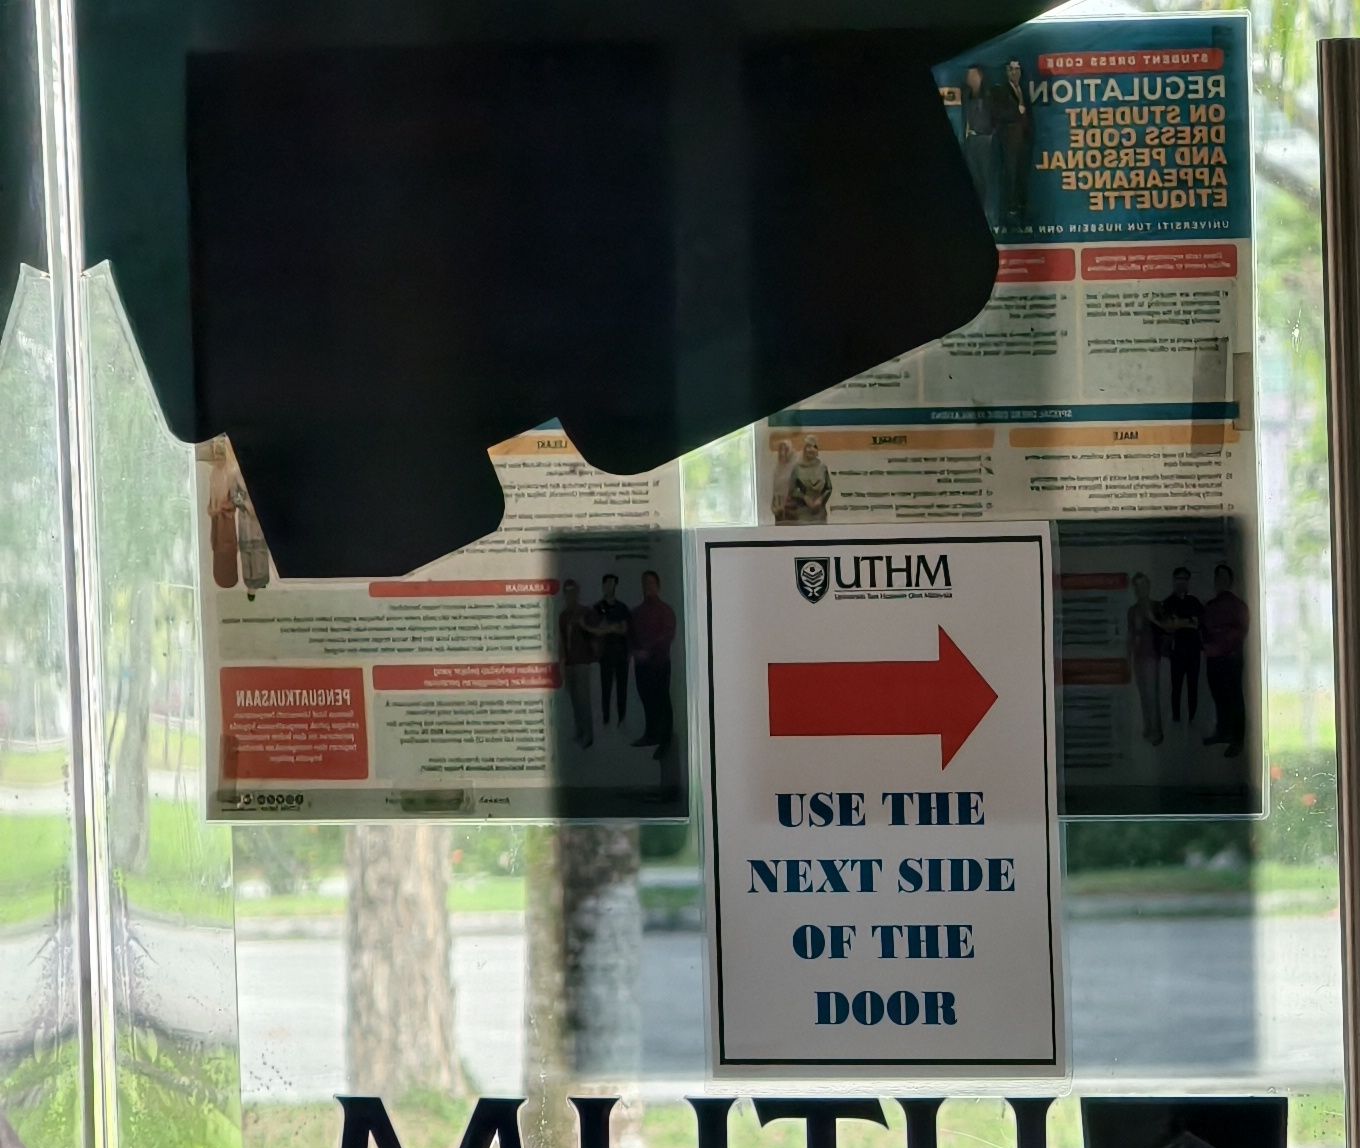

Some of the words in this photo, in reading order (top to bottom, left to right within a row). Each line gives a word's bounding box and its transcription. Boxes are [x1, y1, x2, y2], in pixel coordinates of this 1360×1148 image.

[834, 555, 952, 588] UTHM
[775, 792, 866, 828] USE
[882, 791, 986, 827] THE
[747, 859, 882, 893] NEXT
[898, 858, 1016, 893] SIDE
[793, 925, 857, 960] OF
[871, 925, 975, 959] THE
[814, 991, 958, 1026] DOOR
